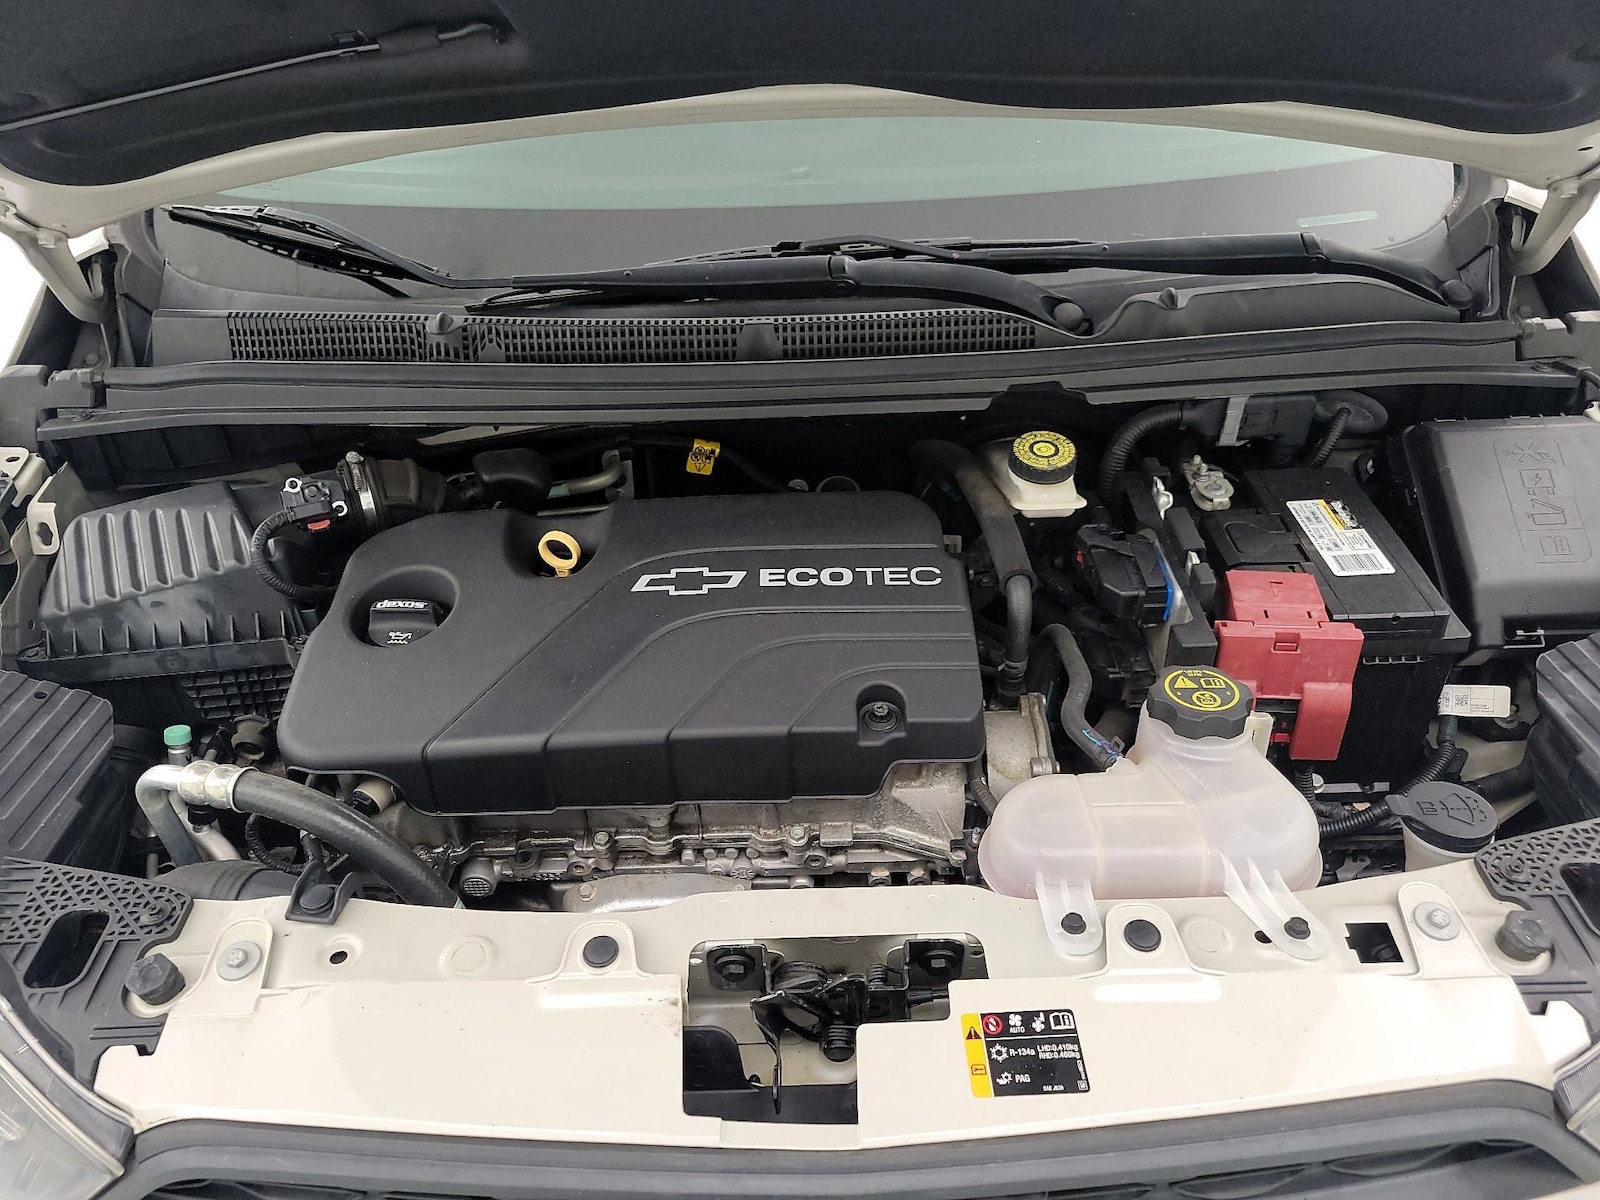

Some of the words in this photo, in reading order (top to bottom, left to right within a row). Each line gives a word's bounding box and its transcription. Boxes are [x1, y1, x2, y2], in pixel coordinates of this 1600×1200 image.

[759, 567, 942, 587] ECOTEC
[376, 600, 426, 609] dexos
[1009, 1047, 1036, 1057] R-134a
[1015, 1074, 1031, 1083] PAG
